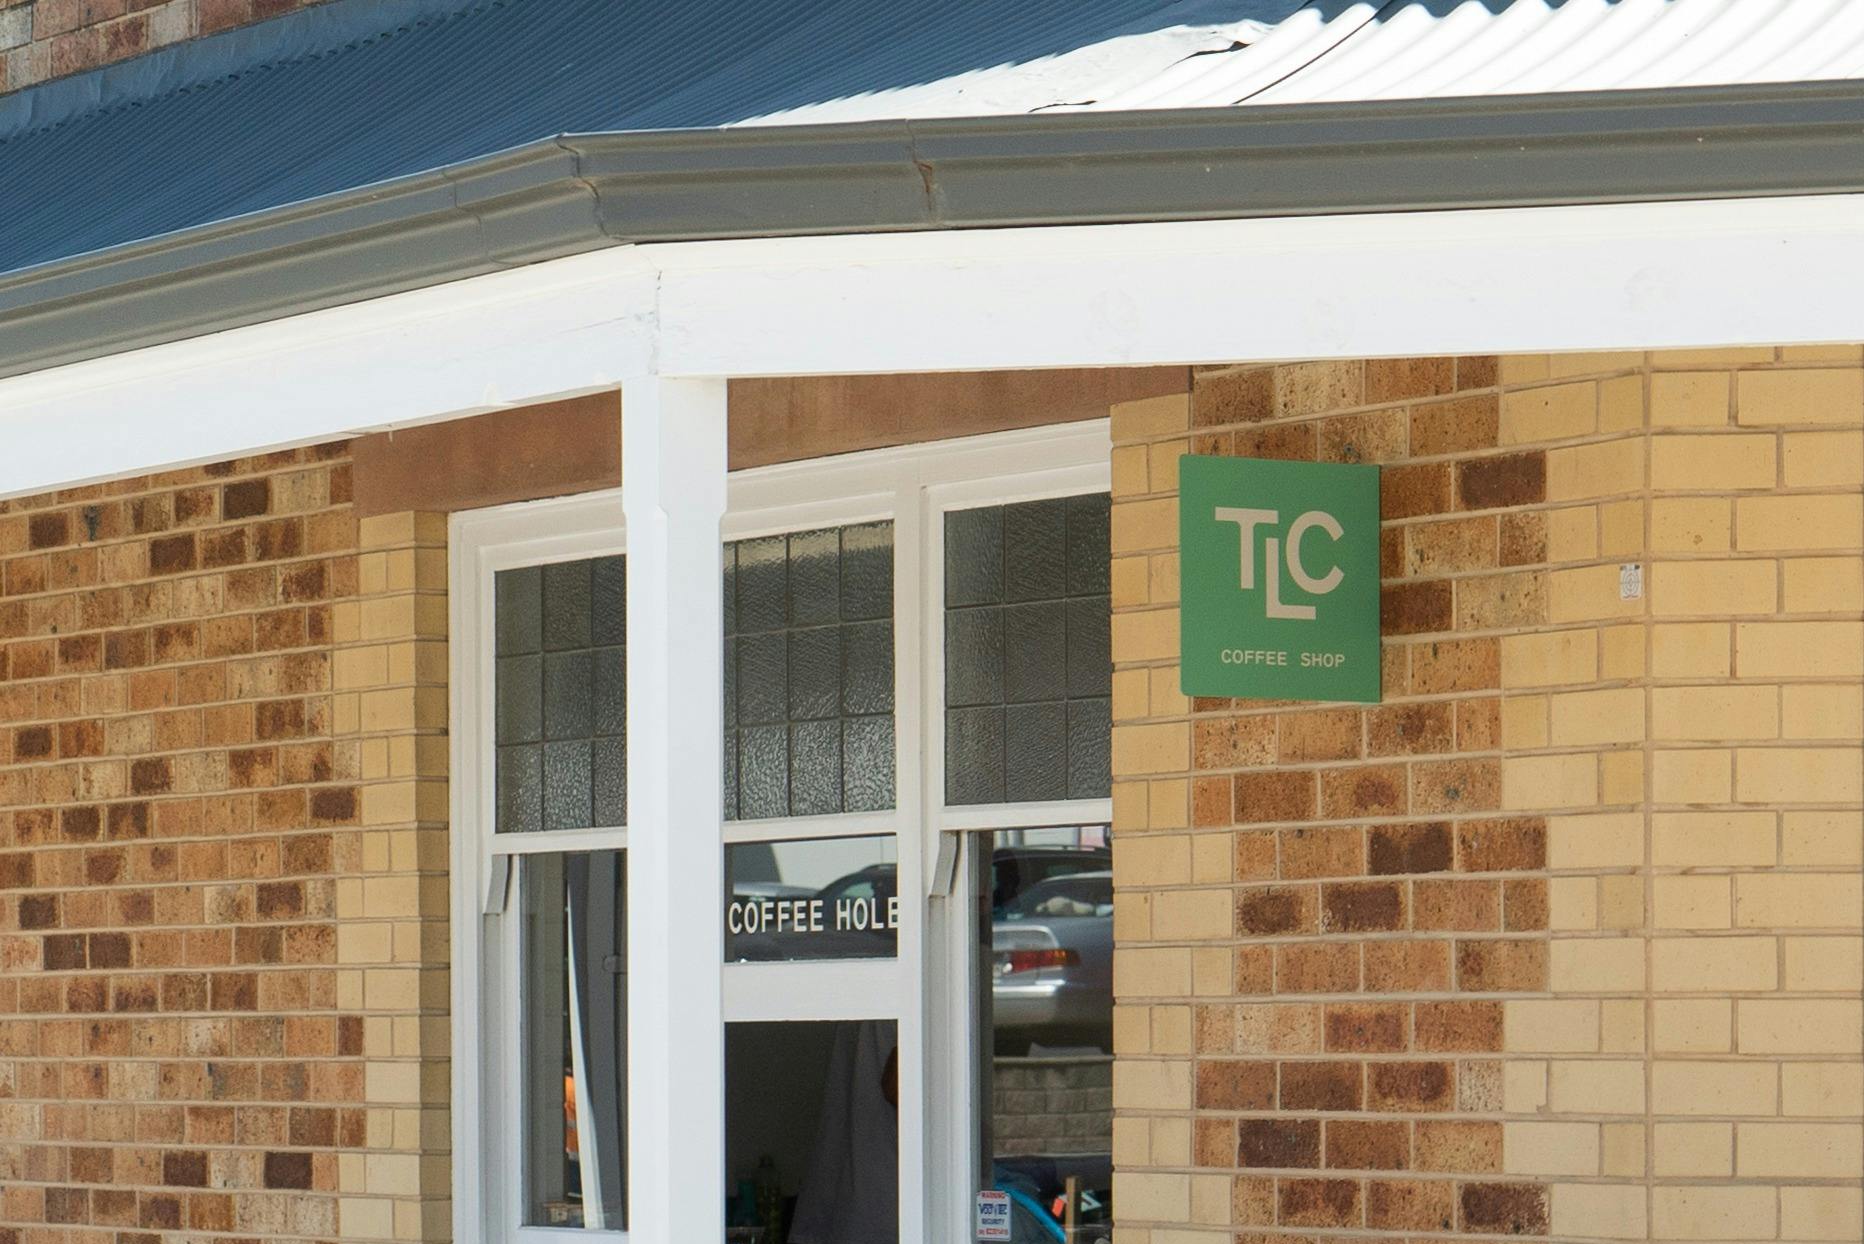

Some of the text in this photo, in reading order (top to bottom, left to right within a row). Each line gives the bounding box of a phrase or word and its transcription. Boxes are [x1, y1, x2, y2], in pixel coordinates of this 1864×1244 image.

[1214, 506, 1345, 620] TLC
[1220, 648, 1345, 668] COFFEE SHOP
[728, 899, 824, 934] COFFEE
